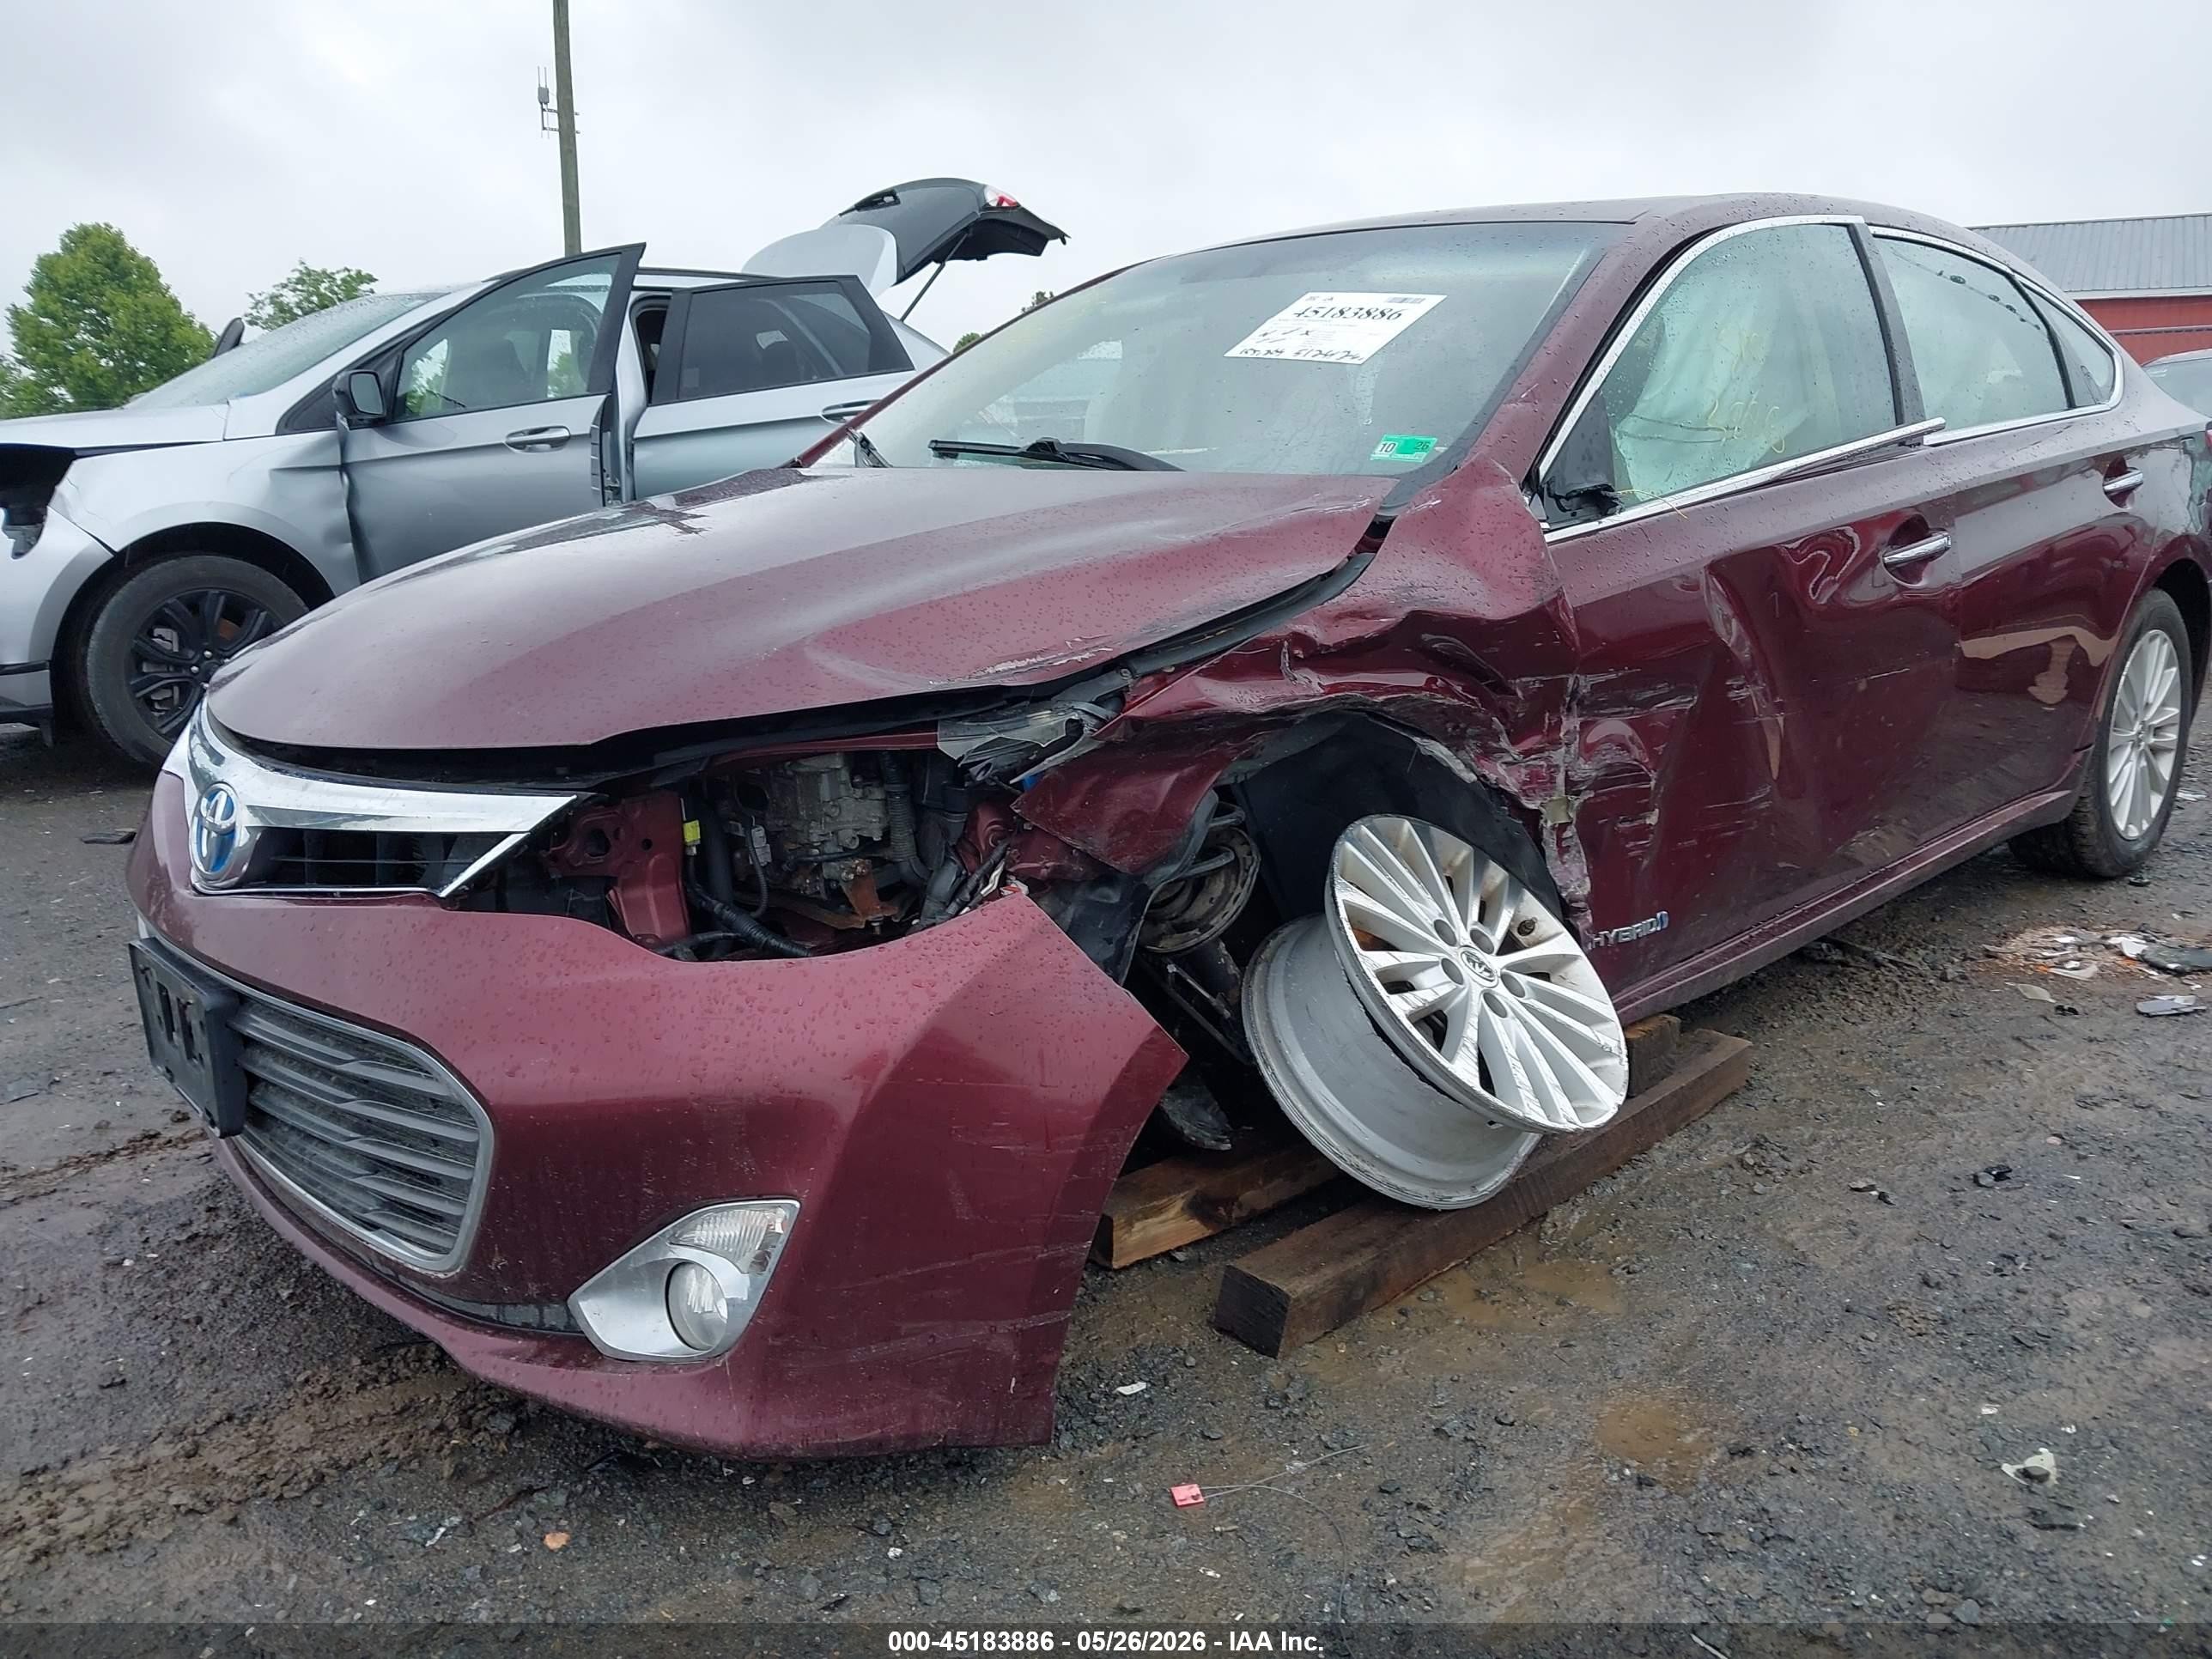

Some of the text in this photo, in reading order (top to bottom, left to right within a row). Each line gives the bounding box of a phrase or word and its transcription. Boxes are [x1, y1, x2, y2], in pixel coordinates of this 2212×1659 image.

[1292, 306, 1408, 320] 45183886
[1379, 442, 1396, 453] 10
[1413, 441, 1431, 451] 26
[1591, 917, 1658, 949] HYBRID
